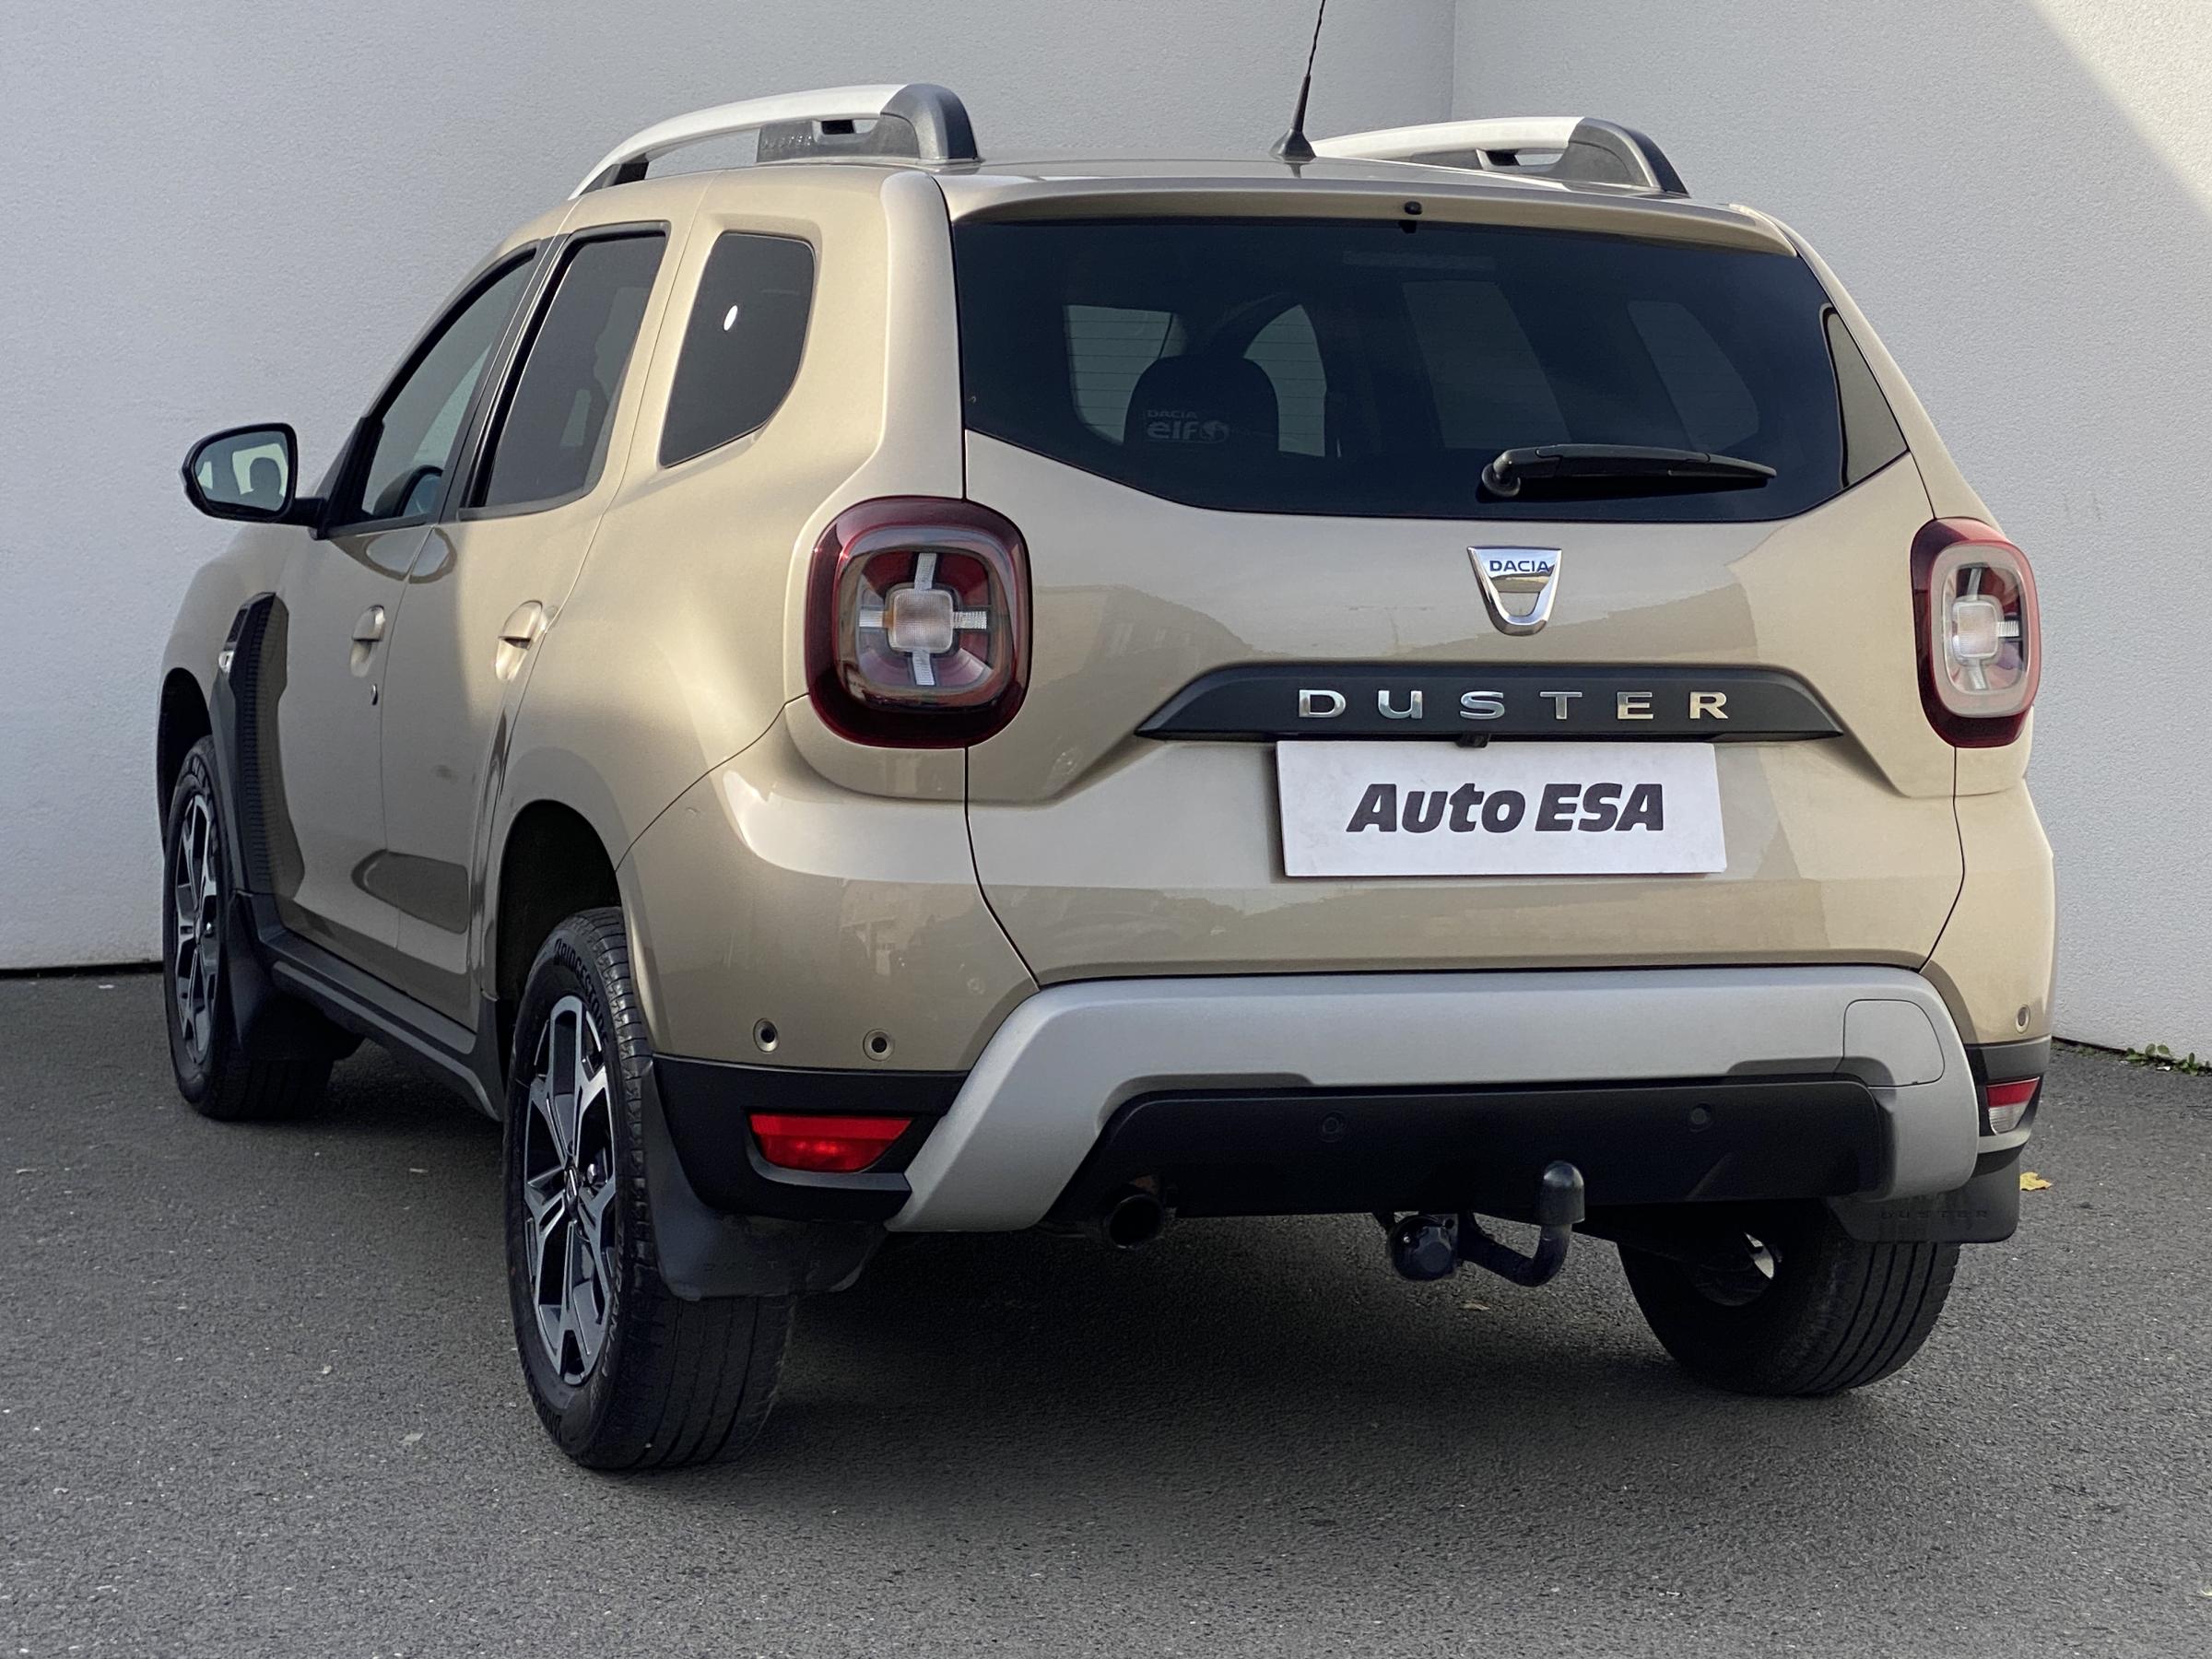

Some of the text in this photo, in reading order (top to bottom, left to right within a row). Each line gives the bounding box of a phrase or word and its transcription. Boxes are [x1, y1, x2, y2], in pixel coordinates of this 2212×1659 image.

[1488, 559, 1550, 572] DACIA
[1298, 689, 1729, 720] DUSTER
[1345, 782, 1665, 833] Auto ESA
